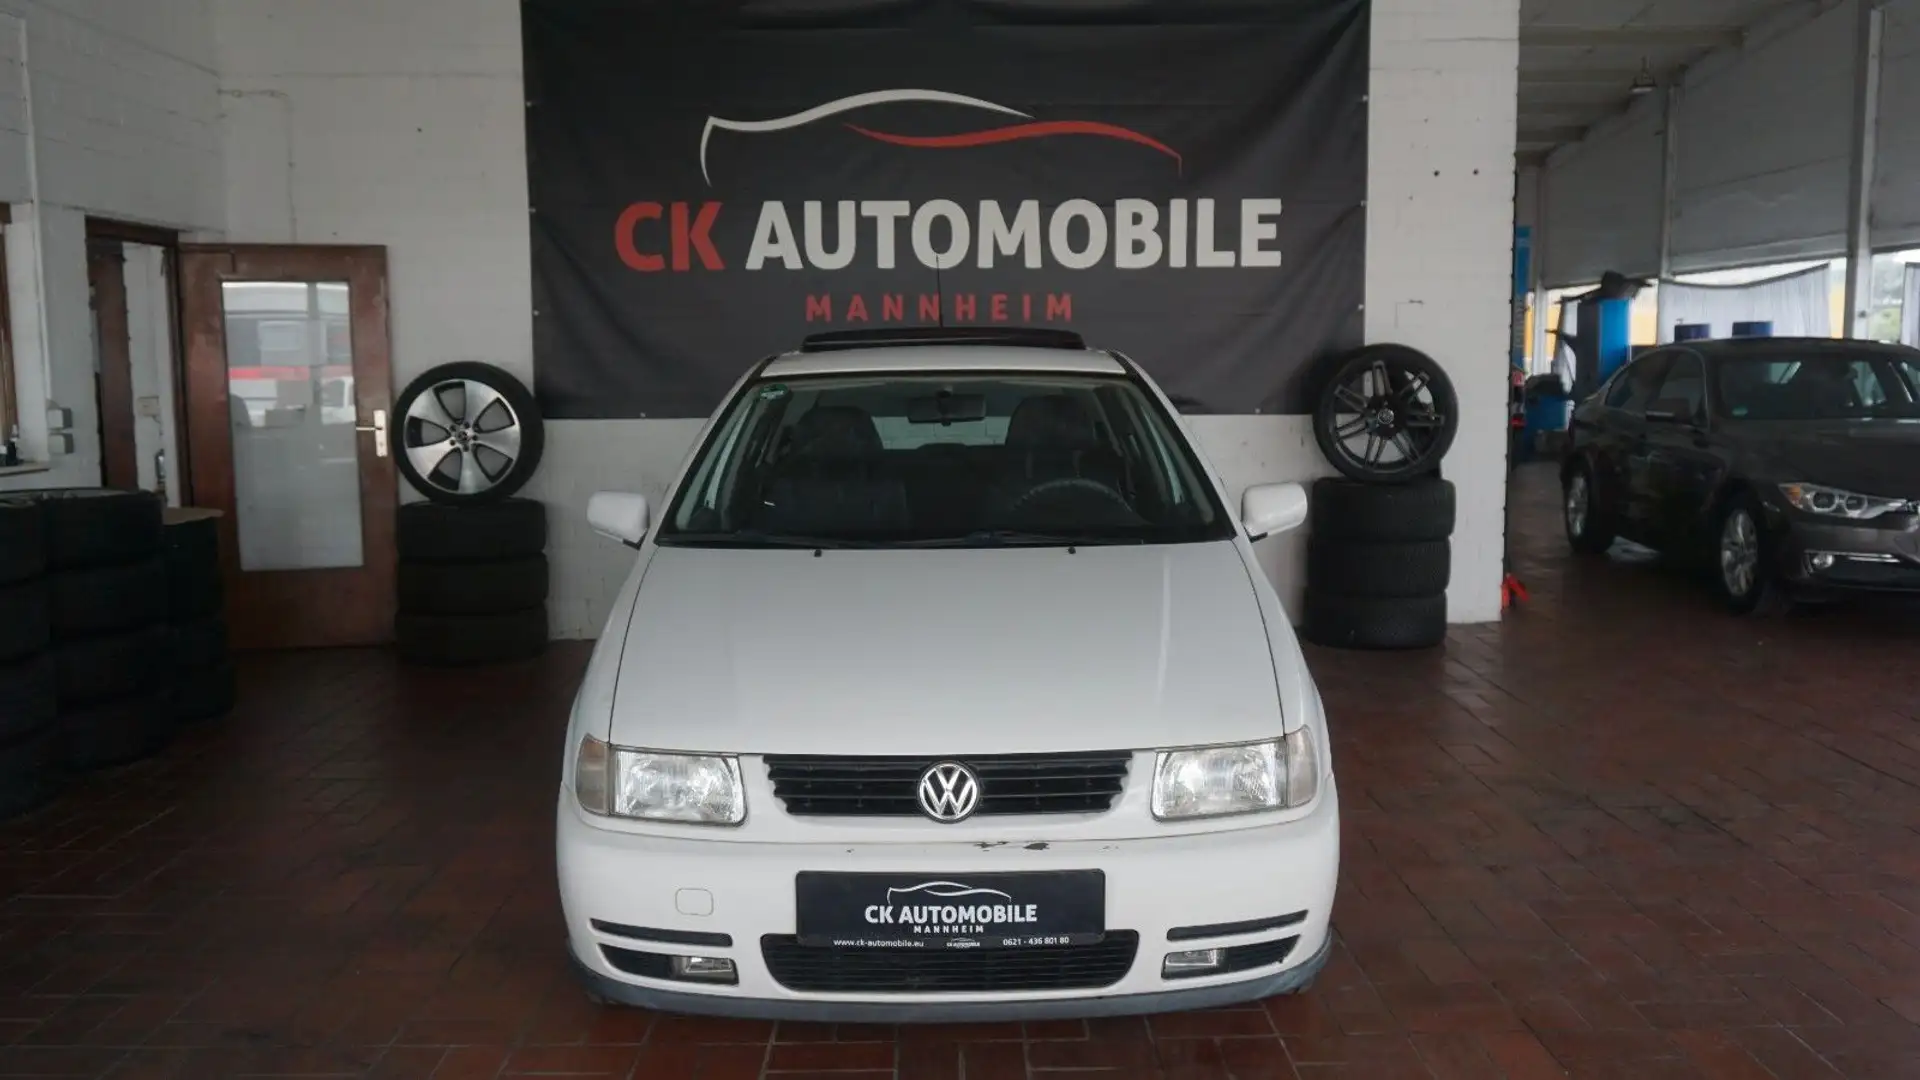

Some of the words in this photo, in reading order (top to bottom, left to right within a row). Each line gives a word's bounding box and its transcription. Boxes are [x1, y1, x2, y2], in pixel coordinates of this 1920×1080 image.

[614, 201, 724, 272] CK
[745, 198, 1283, 270] AUTOMOBILE
[804, 292, 1074, 322] MANNHEIM
[920, 763, 977, 820] VW
[864, 905, 894, 924] CK
[898, 904, 1038, 924] AUTOMOBILE
[913, 925, 984, 934] MANNHEIM
[833, 939, 924, 947] www.ck-automobile.eu
[1003, 938, 1021, 946] 0621
